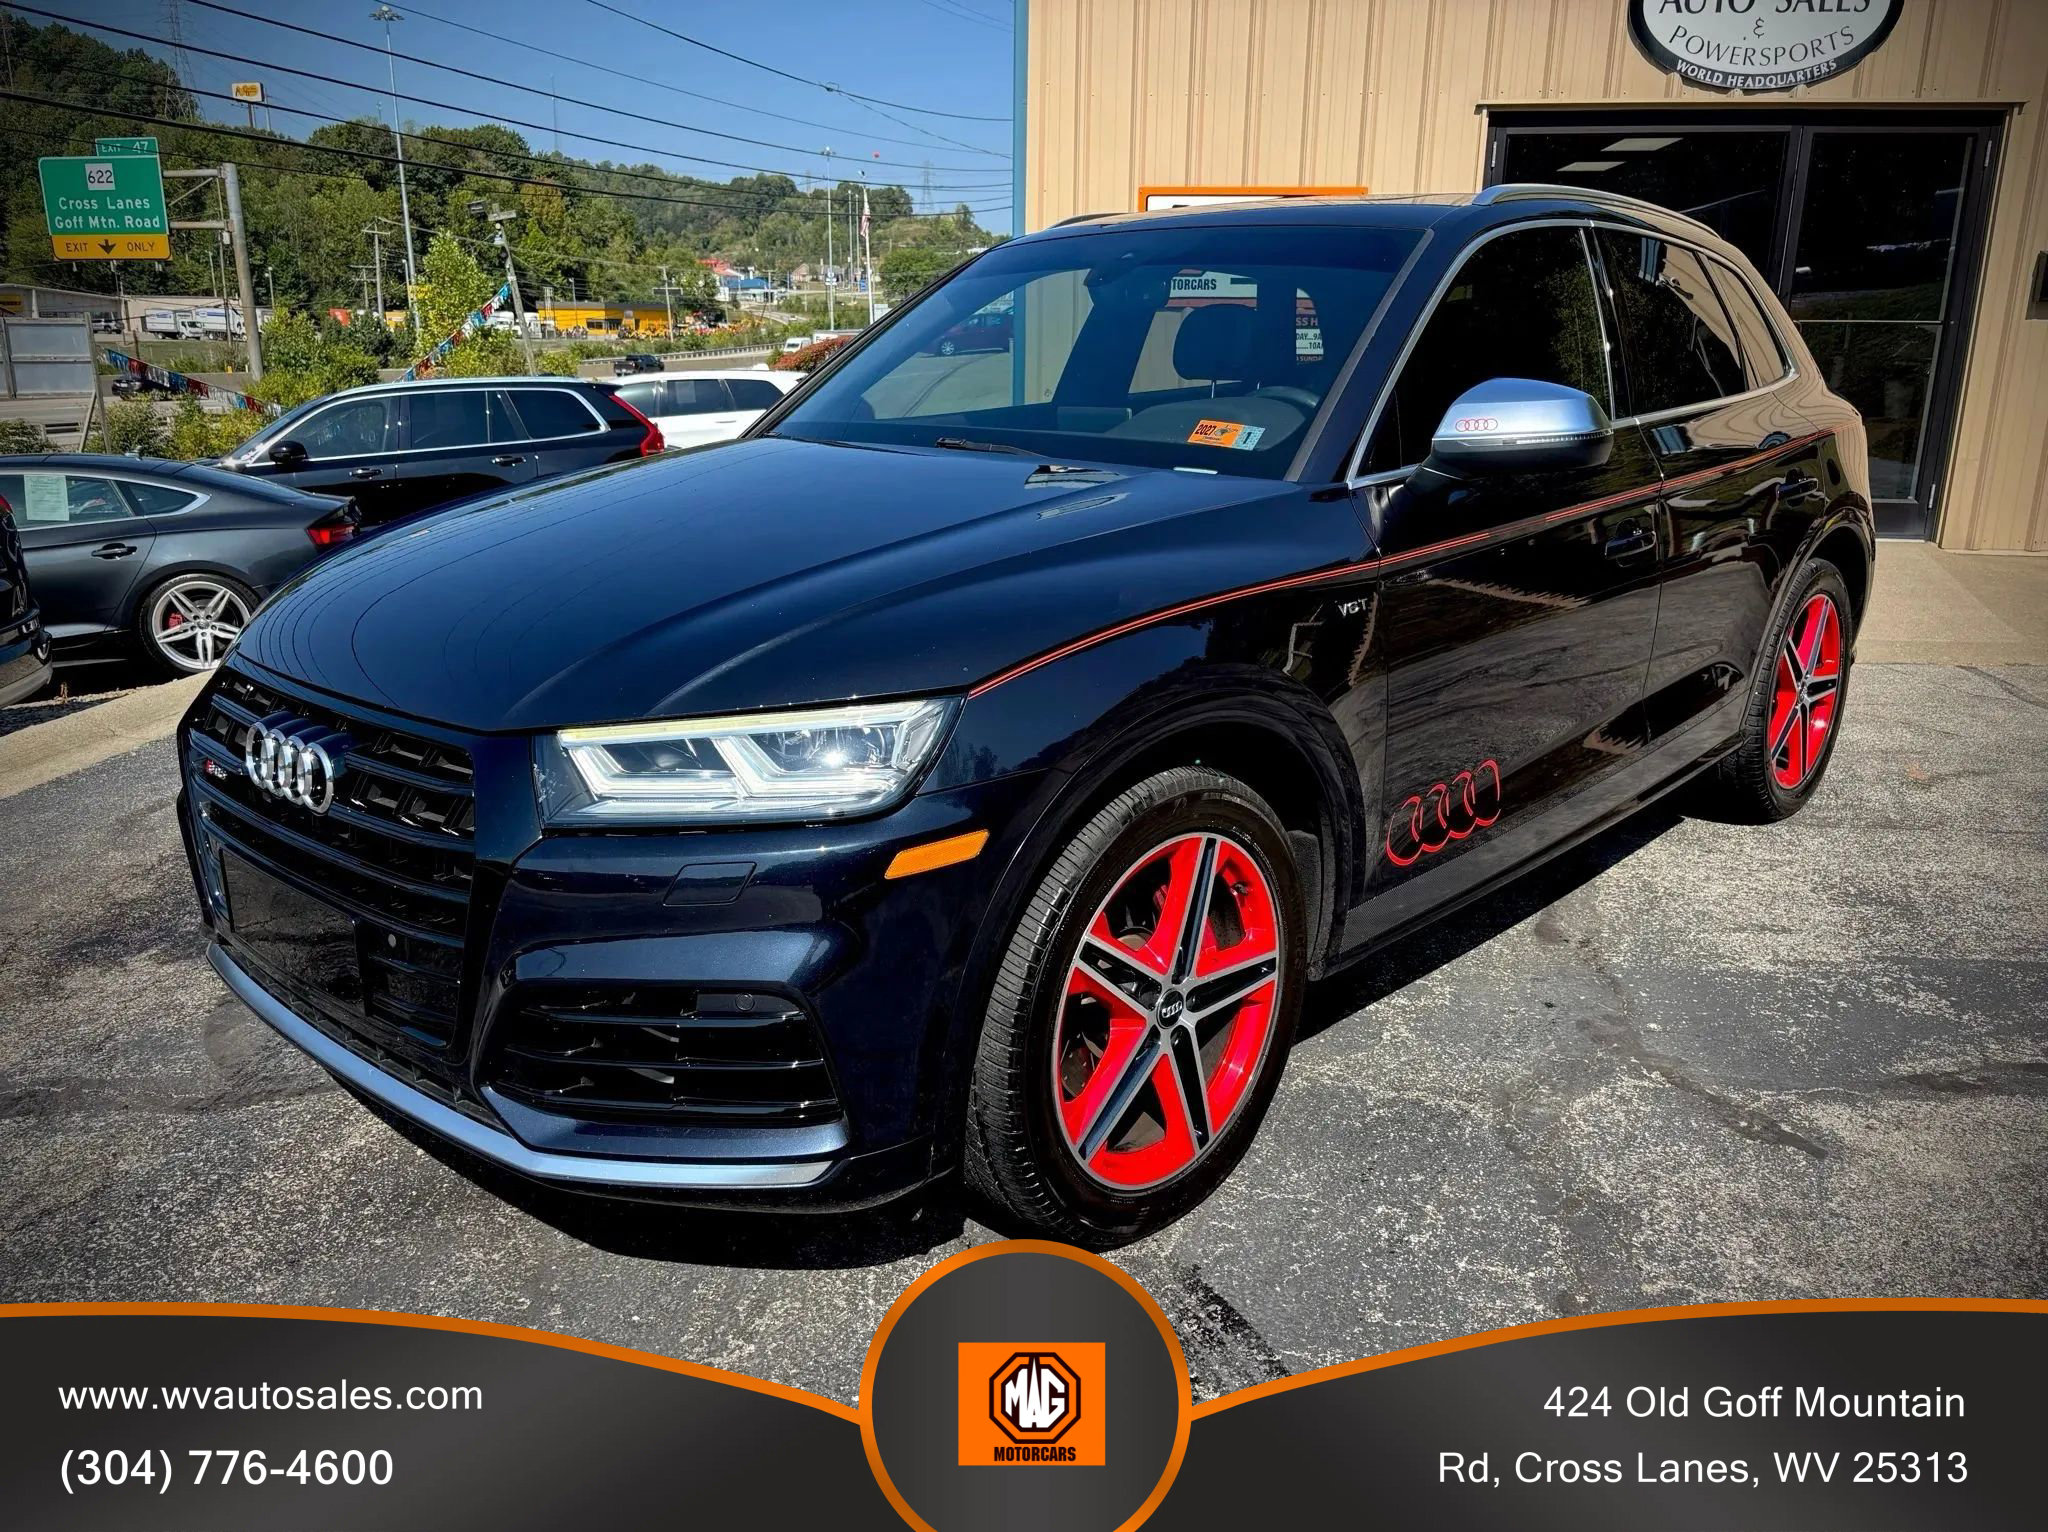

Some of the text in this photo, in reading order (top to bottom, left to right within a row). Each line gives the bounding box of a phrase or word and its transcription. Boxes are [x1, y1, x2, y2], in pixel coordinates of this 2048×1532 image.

[1669, 25, 1854, 67] POWERSPORTS
[1676, 59, 1837, 88] WORLD HEADQUARTERS
[101, 141, 149, 154] EXIT 47
[87, 169, 114, 184] 622
[58, 196, 151, 210] Cross Lanes
[54, 215, 161, 229] Goff Mtn. Road
[65, 242, 156, 252] EXIT ONLY
[1195, 424, 1217, 436] 2027
